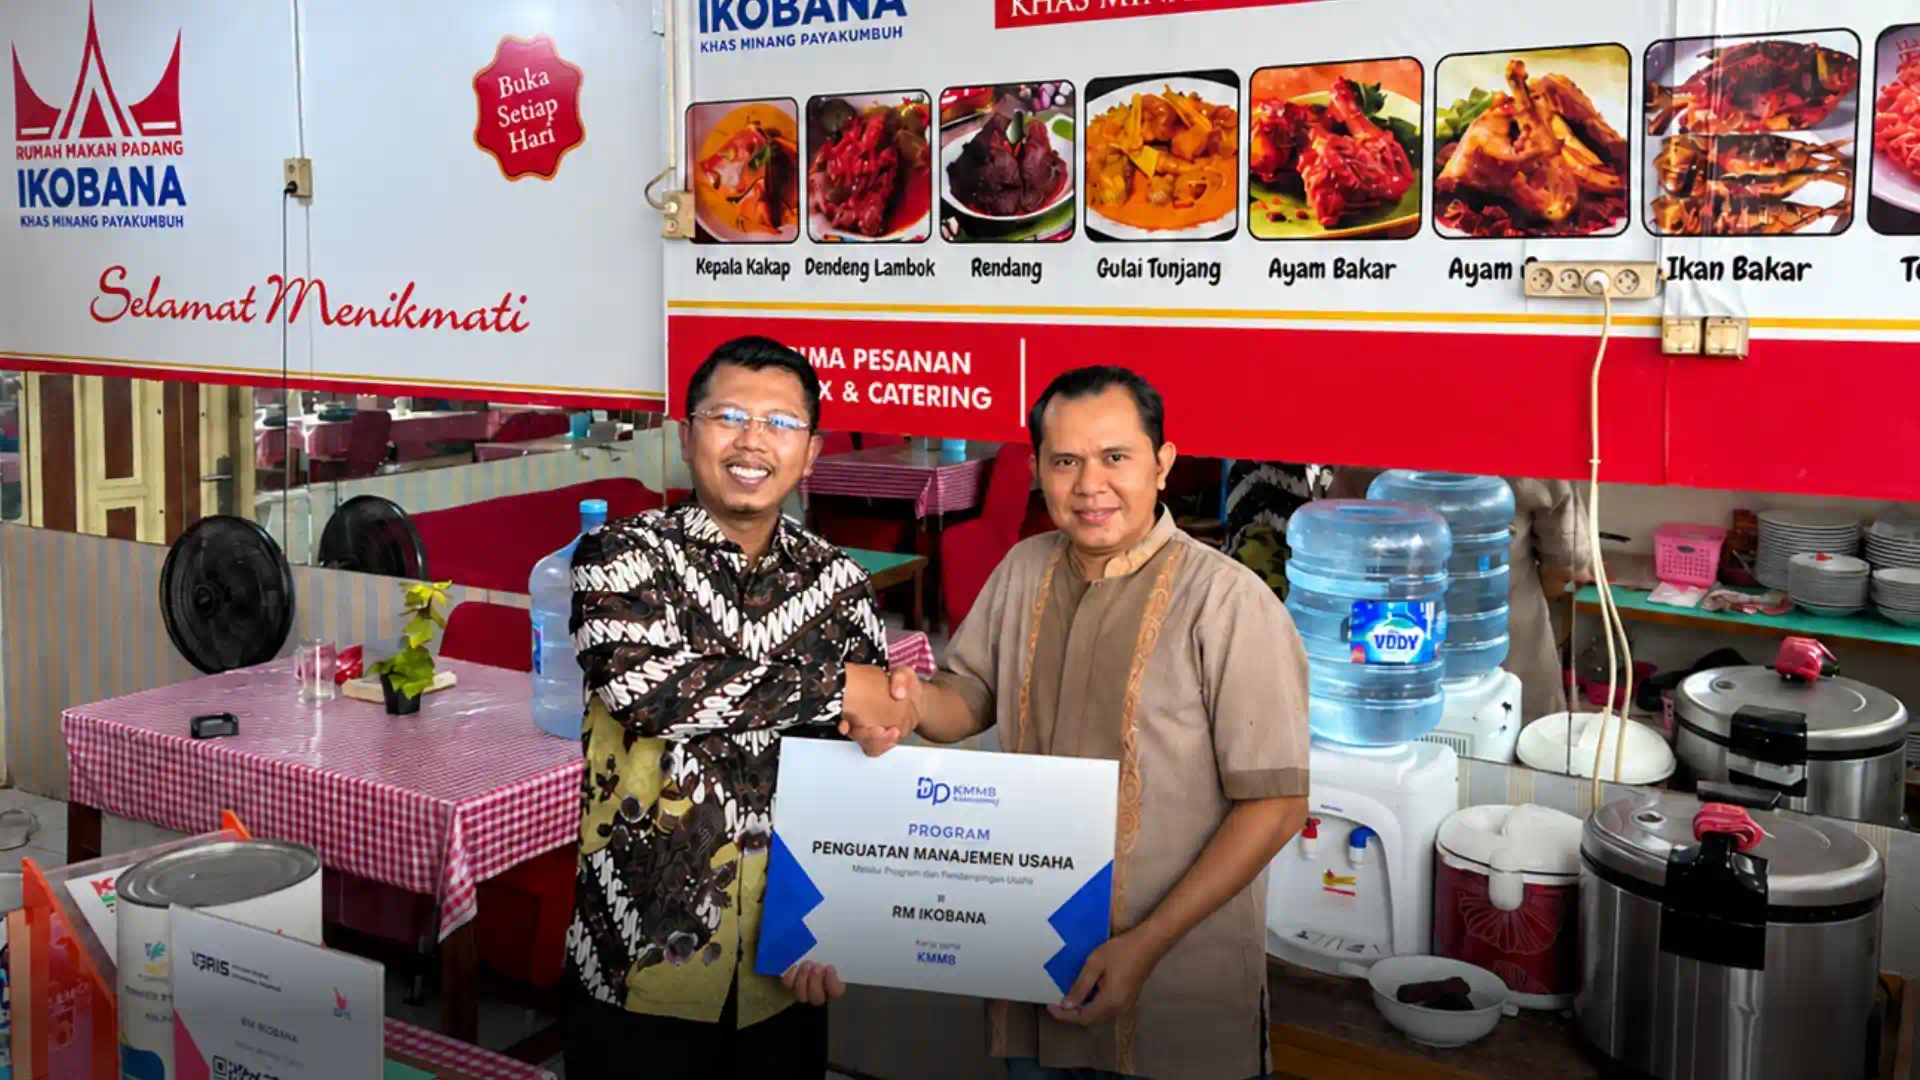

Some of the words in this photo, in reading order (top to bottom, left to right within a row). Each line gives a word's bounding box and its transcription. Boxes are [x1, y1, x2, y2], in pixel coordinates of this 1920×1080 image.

[700, 39, 737, 53] KHAS
[740, 33, 796, 50] MINANG
[800, 25, 903, 46] PAYAKUMBUH
[498, 67, 550, 98] Buka
[497, 98, 558, 128] Setiap
[16, 144, 62, 160] RUMAH
[66, 143, 116, 158] MAKAN
[121, 140, 184, 157] PADANG
[508, 121, 556, 154] Hari
[17, 165, 186, 208] IKOBANA
[20, 215, 49, 228] KHAS
[52, 215, 98, 228] MINANG
[102, 215, 184, 228] PAYAKUMBUH
[696, 257, 743, 280] Kepala
[746, 257, 791, 281] Kakap
[804, 257, 869, 283] Dendeng
[874, 257, 936, 277] Lambok
[971, 257, 1042, 284] Rendang
[1097, 257, 1143, 278] Gulai
[1147, 258, 1221, 286] Tunjang
[1268, 257, 1326, 286] Ayam
[1333, 256, 1397, 279] Bakar
[1449, 257, 1513, 287] Ayam
[1666, 256, 1725, 281] Ikan
[1732, 255, 1812, 281] Bakar
[1900, 255, 1920, 282] T
[90, 265, 257, 323] Selamat
[264, 274, 530, 333] Menikmati
[853, 348, 971, 375] PESANAN
[842, 381, 860, 403] &
[868, 381, 992, 410] CATERING
[908, 823, 991, 841] PROGRAM
[812, 840, 909, 860] PENGUATAN
[913, 846, 1015, 867] MANAJEMEN
[1018, 853, 1075, 871] USAHA
[892, 905, 915, 920] RM
[918, 907, 987, 926] IKOBANA
